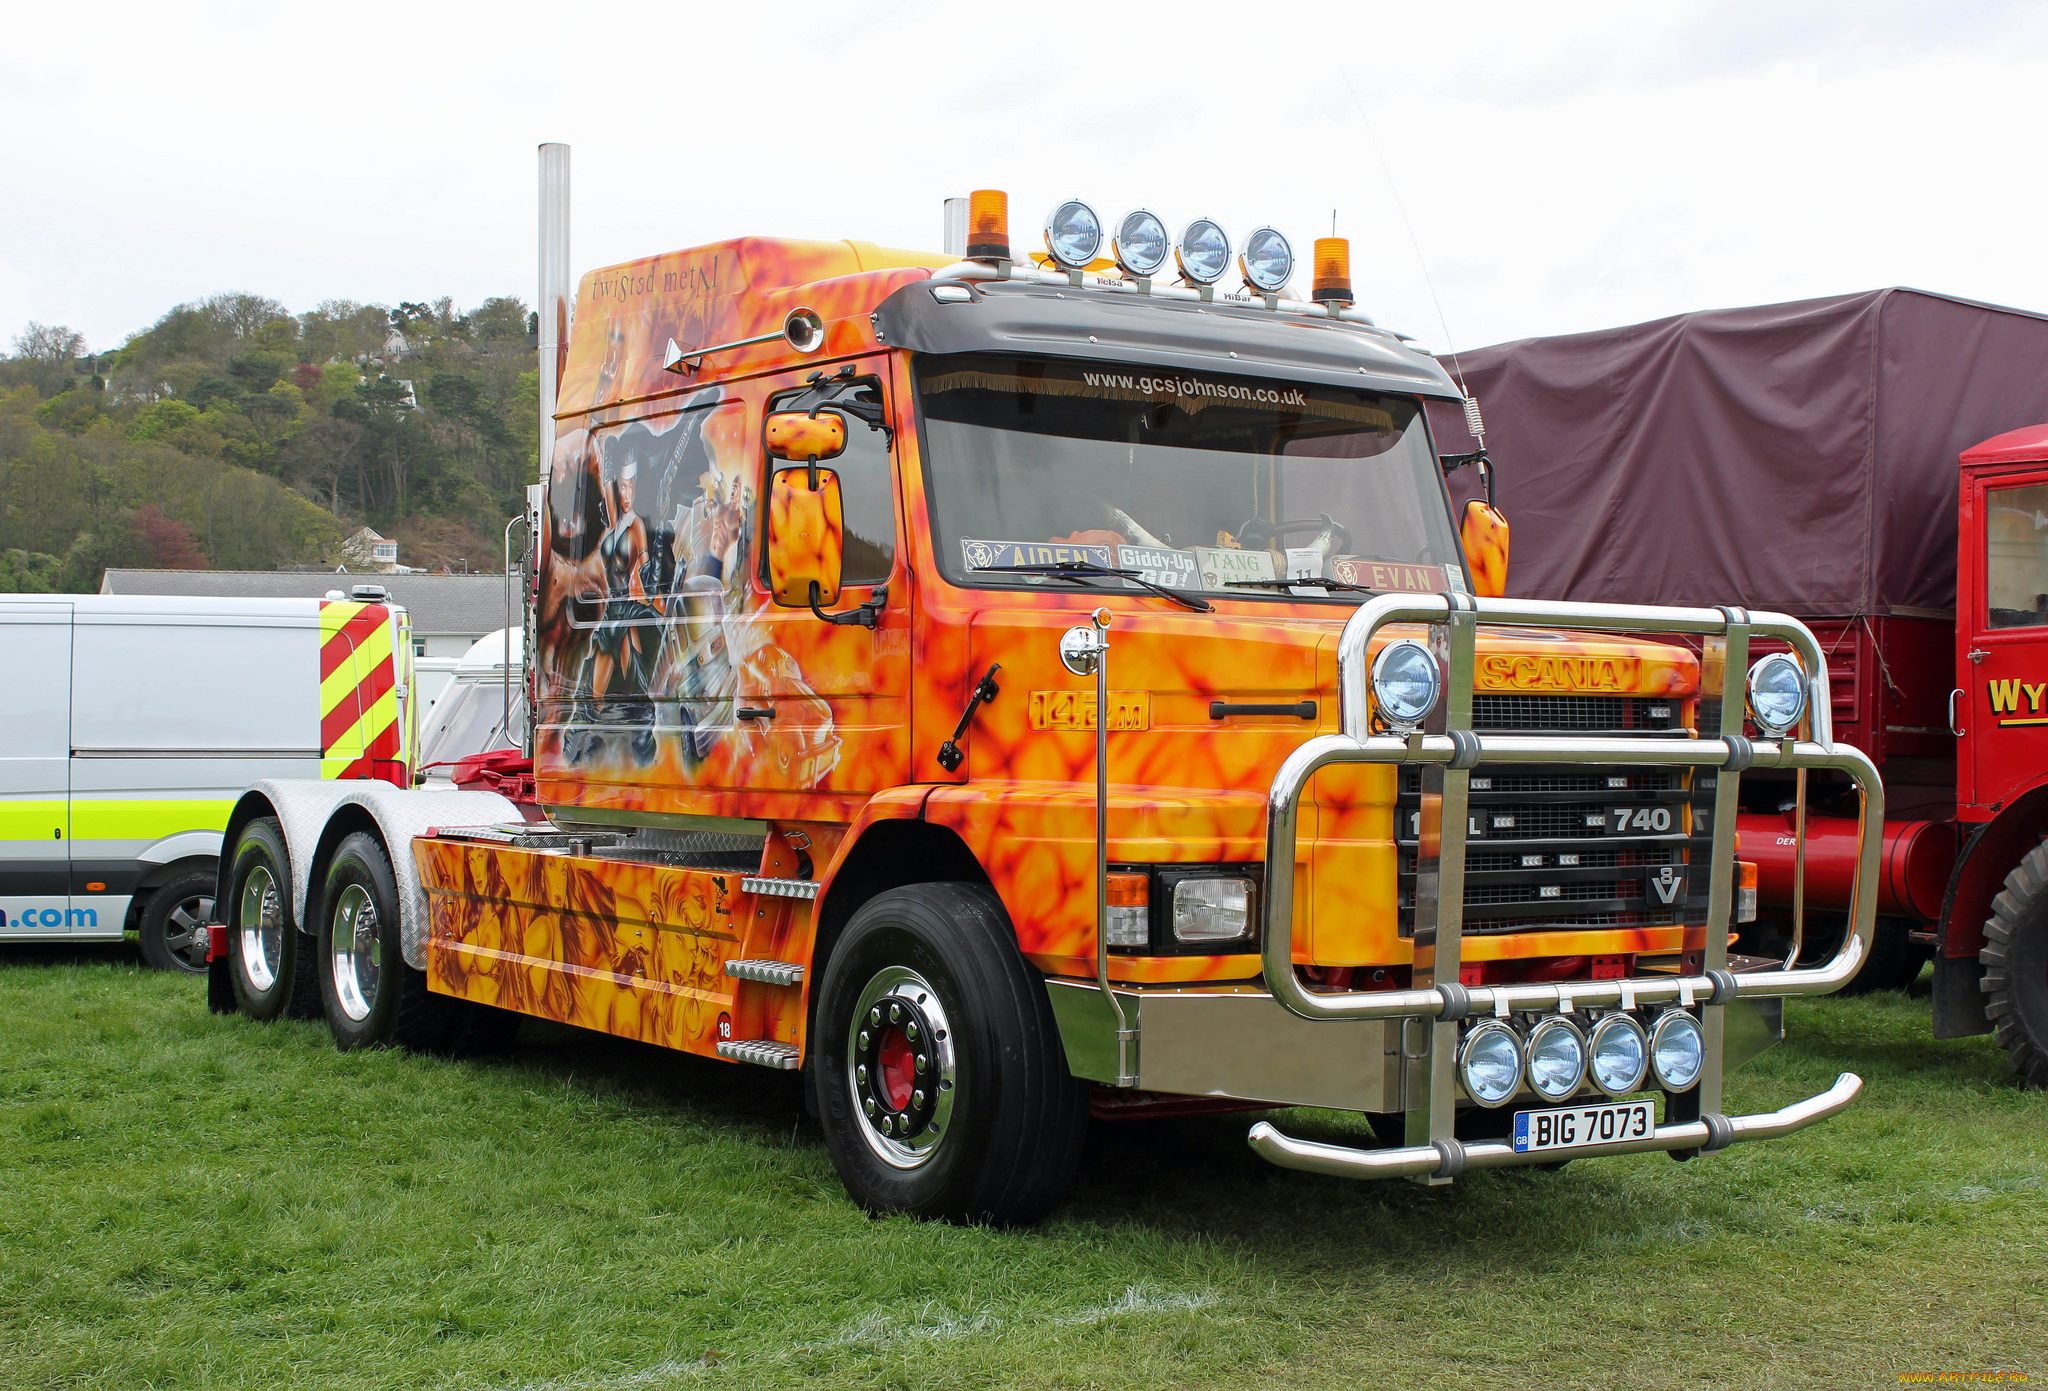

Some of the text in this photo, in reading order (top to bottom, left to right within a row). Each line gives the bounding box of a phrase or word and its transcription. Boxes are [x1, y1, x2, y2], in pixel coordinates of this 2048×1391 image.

[1223, 293, 1251, 303] HiBar
[1083, 372, 1307, 407] www.gcsjohnson.co.uk
[1013, 546, 1089, 567] AIDEN
[1121, 549, 1195, 574] Giddy-Up
[1208, 552, 1260, 572] TANG
[1372, 566, 1432, 591] EVAN
[1482, 655, 1621, 691] SCANIA
[1987, 678, 2048, 716] WY
[1613, 808, 1671, 831] 740
[719, 1021, 731, 1039] 18
[1536, 1106, 1647, 1146] BIG 7073
[1516, 1136, 1528, 1145] GB
